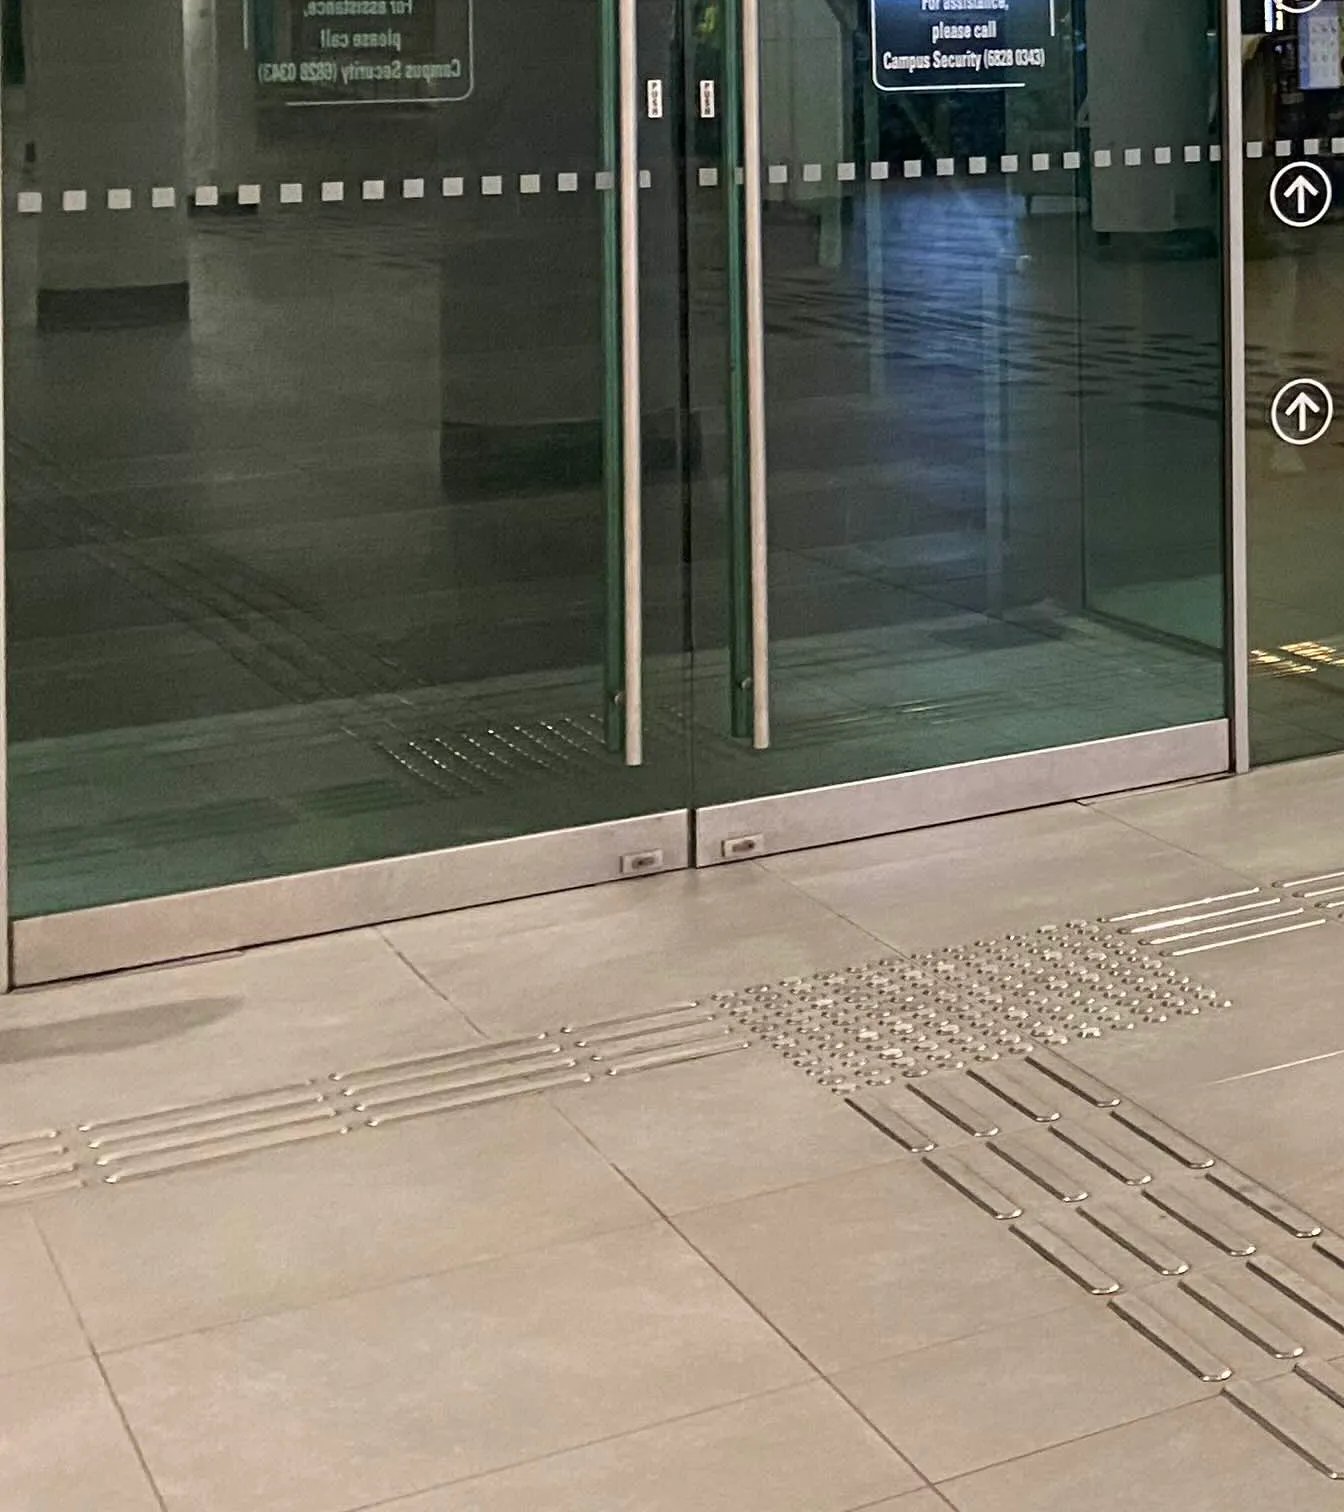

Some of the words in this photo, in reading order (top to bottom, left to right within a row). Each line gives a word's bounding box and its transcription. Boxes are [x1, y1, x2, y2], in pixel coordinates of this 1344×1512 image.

[932, 21, 971, 44] please
[974, 20, 997, 38] call
[883, 51, 930, 73] Campus
[933, 50, 981, 71] Security
